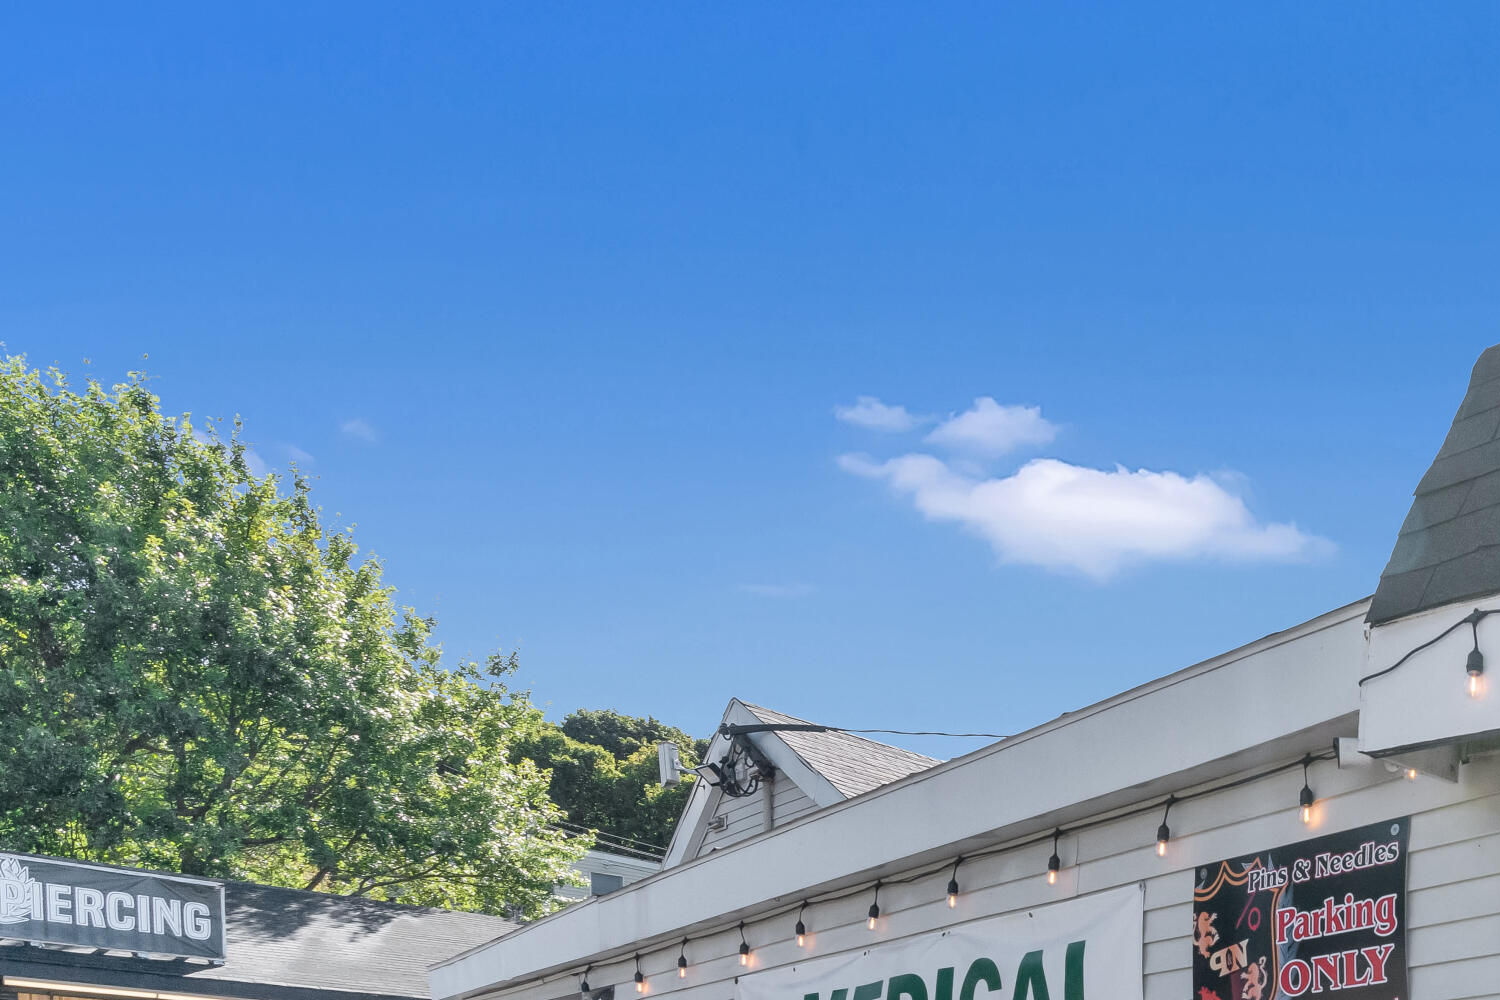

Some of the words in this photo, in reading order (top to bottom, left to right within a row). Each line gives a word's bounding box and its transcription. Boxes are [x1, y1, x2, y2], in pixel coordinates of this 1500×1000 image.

[1248, 866, 1289, 894] Pins
[1292, 858, 1310, 883] &
[1314, 841, 1400, 879] Needles
[1276, 892, 1398, 945] Parking
[1280, 943, 1396, 998] ONLY
